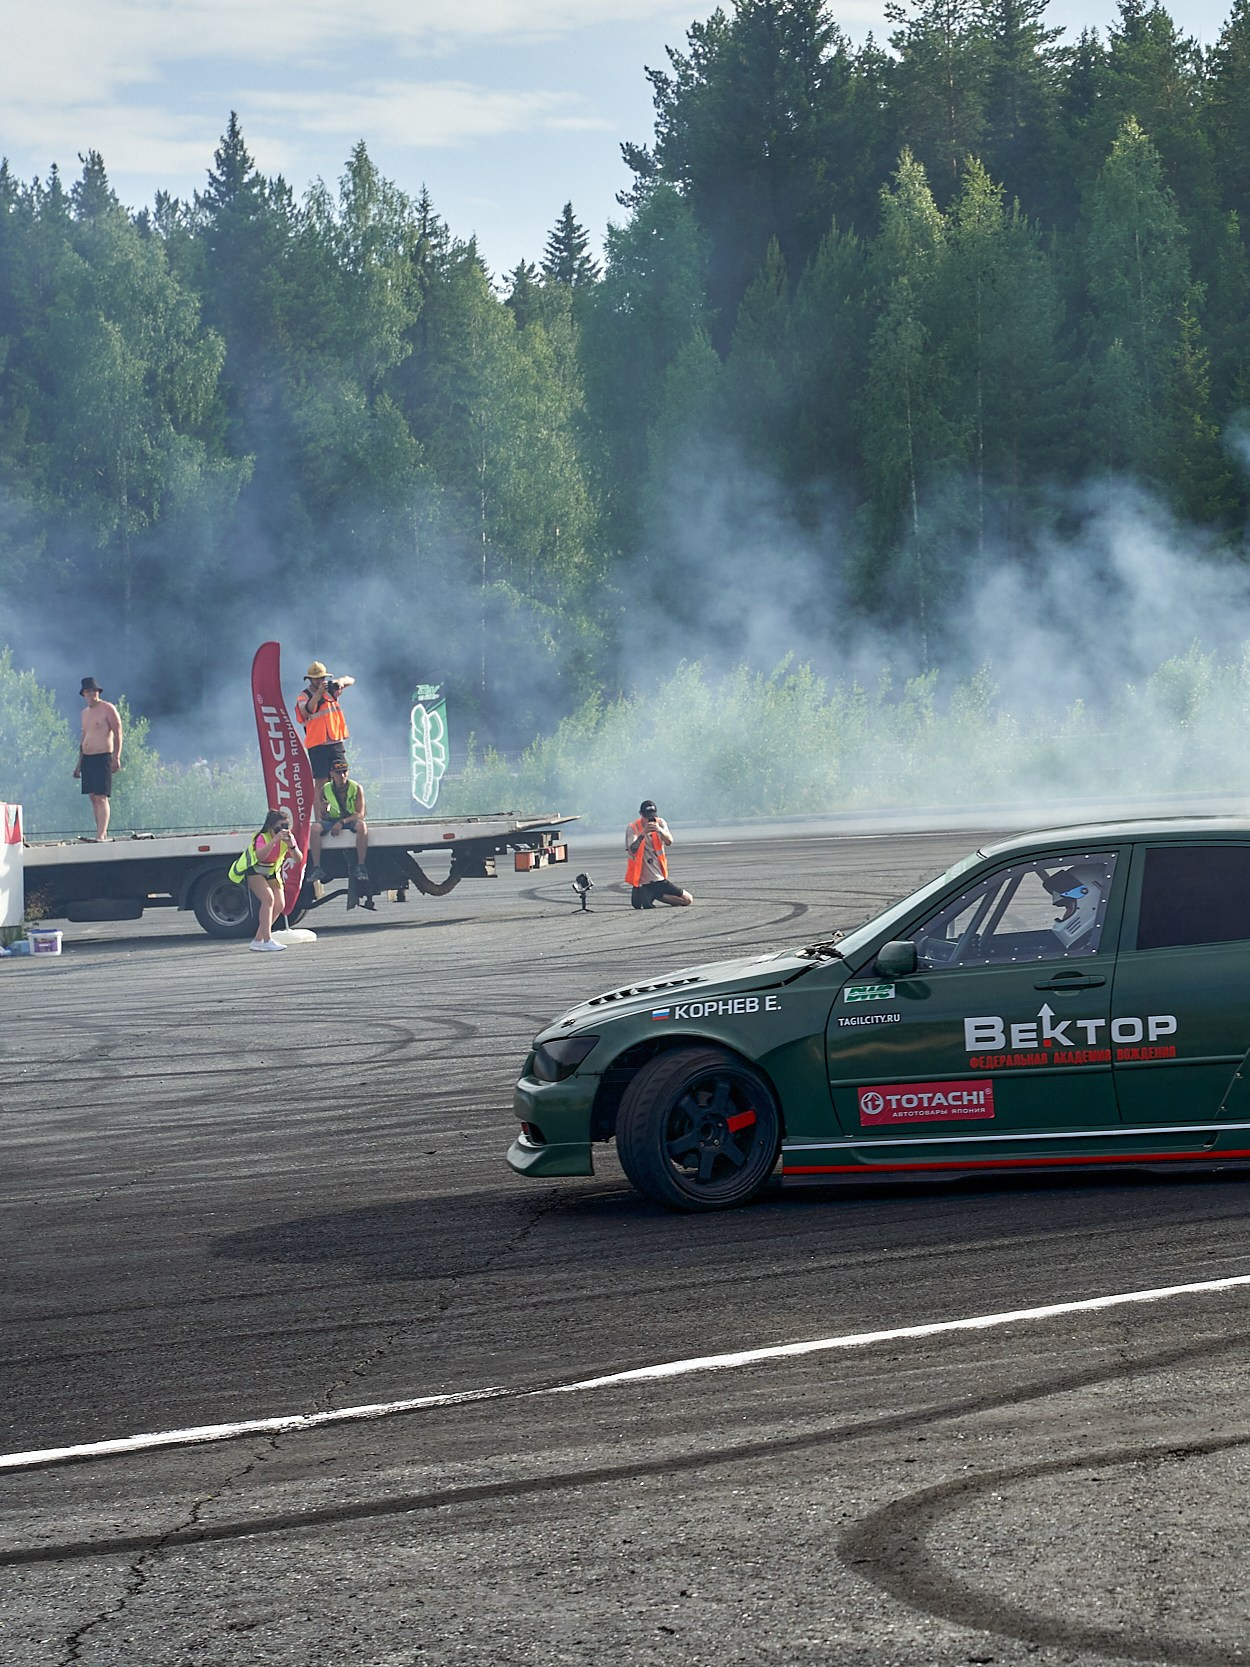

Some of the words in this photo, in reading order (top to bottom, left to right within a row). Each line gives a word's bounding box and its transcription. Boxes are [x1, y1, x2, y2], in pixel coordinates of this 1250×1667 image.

[261, 706, 294, 831] OTACHI
[293, 763, 306, 827] ОТОВАРЫ
[674, 996, 760, 1020] КОРНЕВ
[765, 995, 782, 1012] Е.
[838, 1013, 901, 1027] TAGILCITY.RU
[969, 1052, 1048, 1069] ФЕДЕРАЛЬНАЯ
[1053, 1048, 1111, 1064] АКАДЕМИЯ
[1117, 1045, 1177, 1061] ВОЖДЕНИЯ
[886, 1090, 985, 1109] TOTACHI
[892, 1109, 948, 1118] АВТОТОВАРЫ
